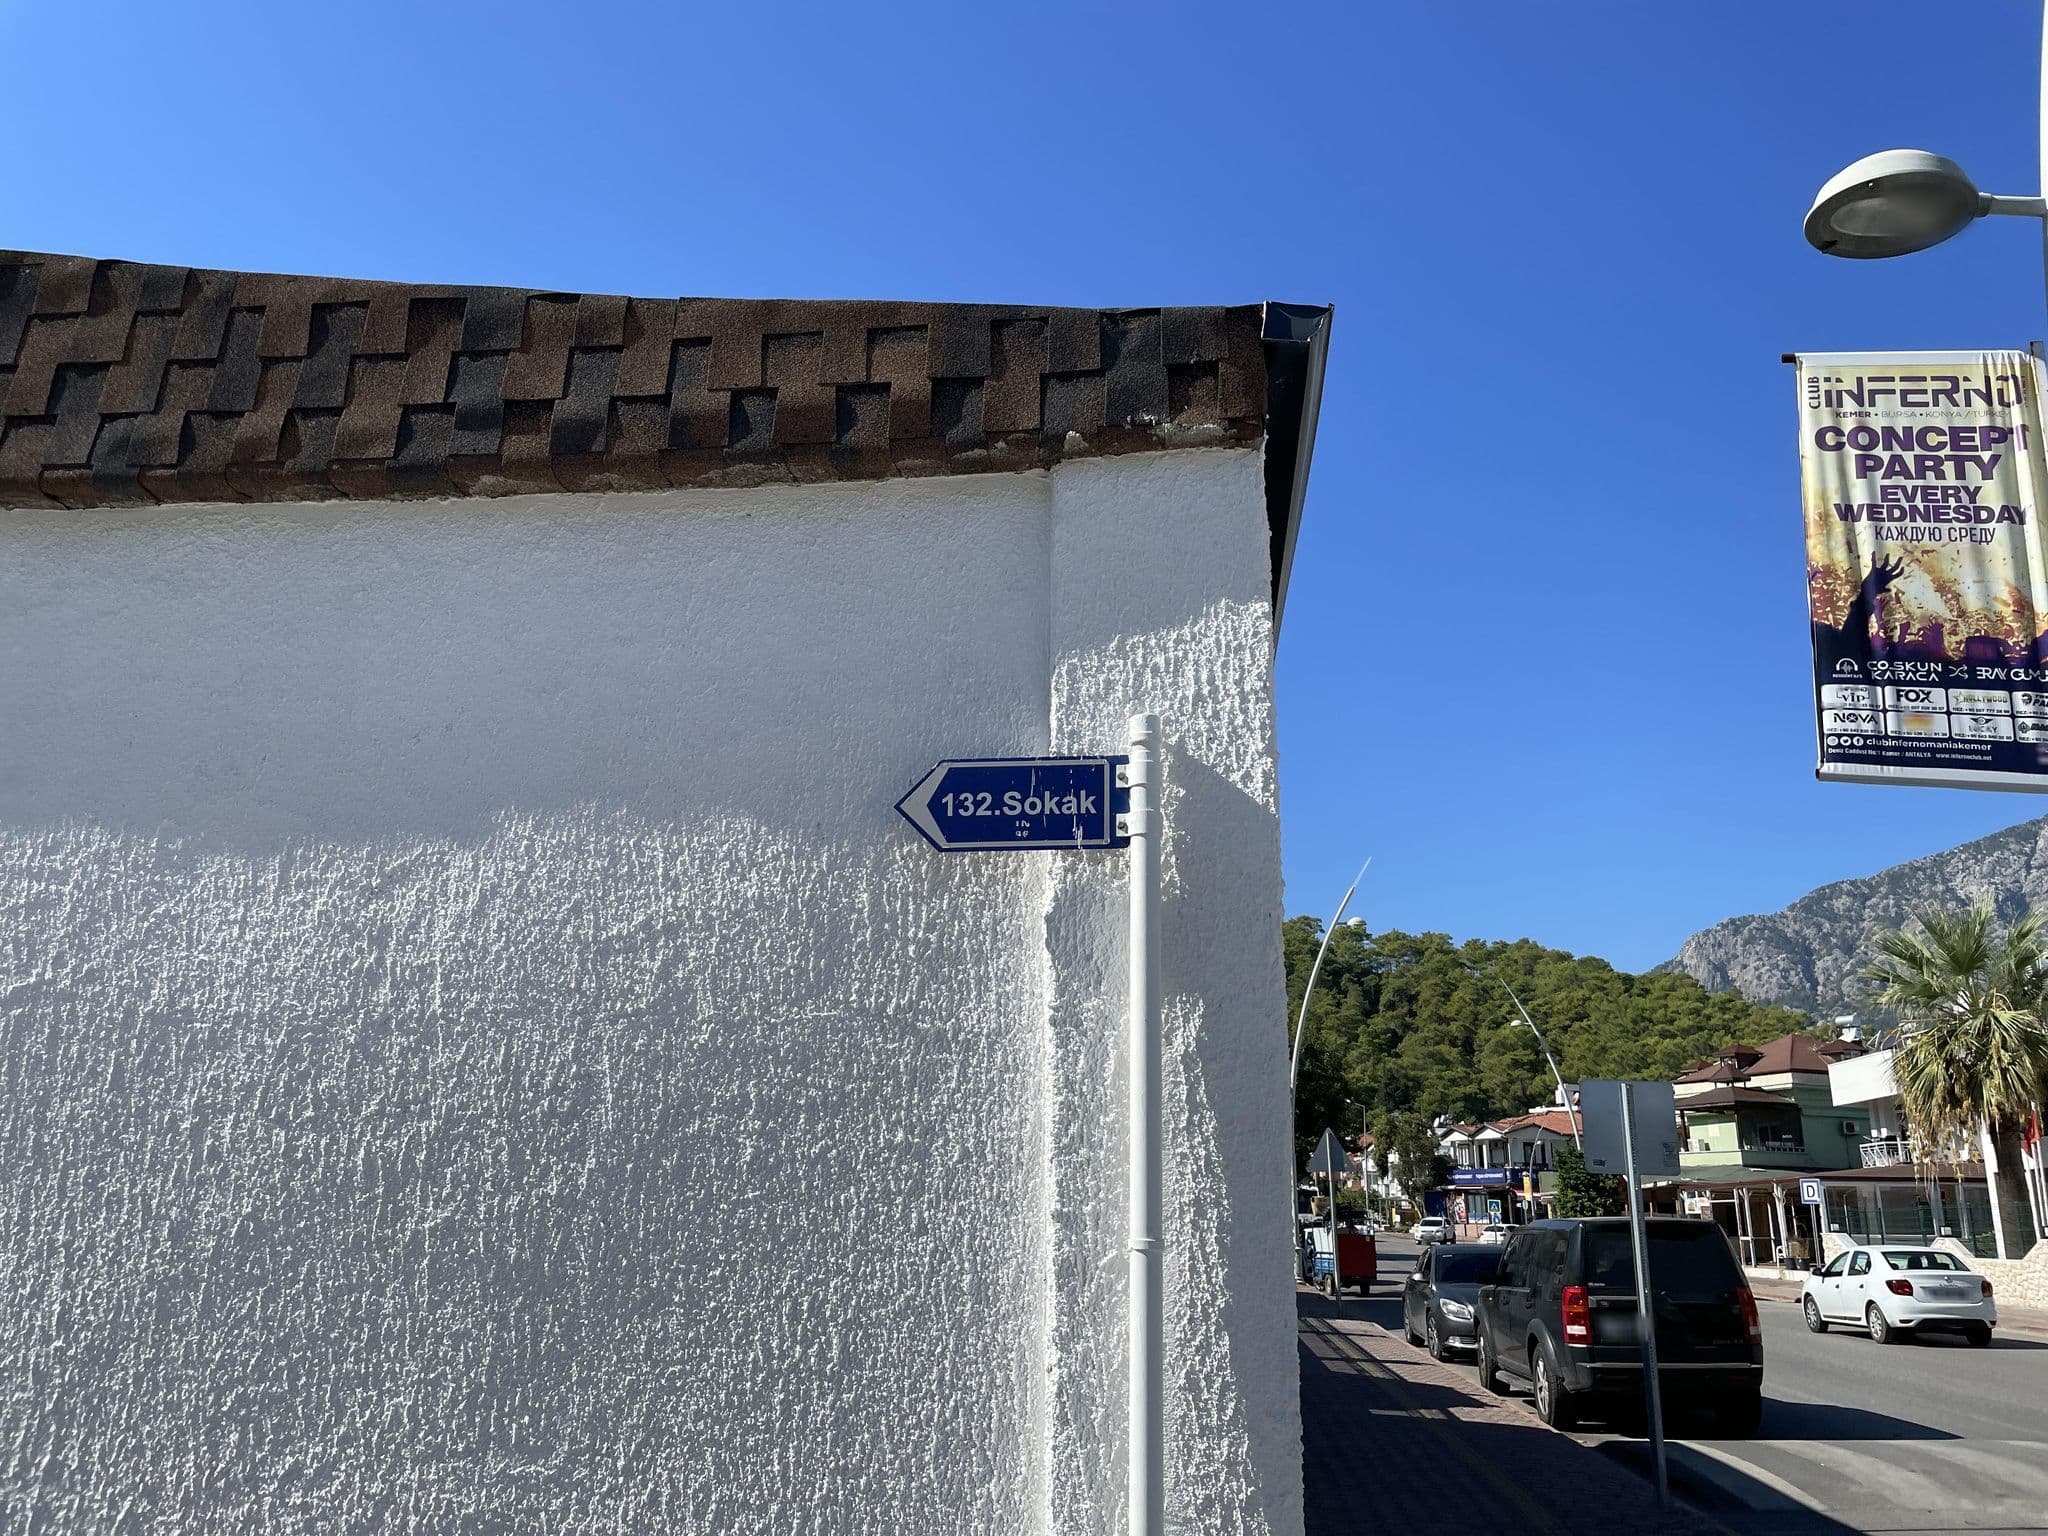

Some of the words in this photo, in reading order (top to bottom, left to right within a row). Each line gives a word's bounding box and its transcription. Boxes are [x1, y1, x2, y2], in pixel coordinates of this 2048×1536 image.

[1807, 376, 1820, 409] CLUB
[1835, 411, 1871, 419] KEMER
[1881, 411, 1917, 419] BURSA
[1925, 411, 1962, 419] KONYA
[1855, 454, 2002, 480] PARTY
[1880, 485, 1982, 505] EVERY
[1833, 503, 2028, 526] WEDNESDAY
[1874, 525, 1943, 545] КАЖДУЮ
[1947, 527, 1997, 546] СРЕДУ
[1872, 671, 1940, 682] KARACA
[1896, 689, 1935, 704] FOX
[1833, 713, 1879, 725] NOVA
[1867, 738, 1992, 751] clubinfernomaniakemer
[941, 791, 1097, 817] 132.Sokak
[1806, 1185, 1815, 1197] D
